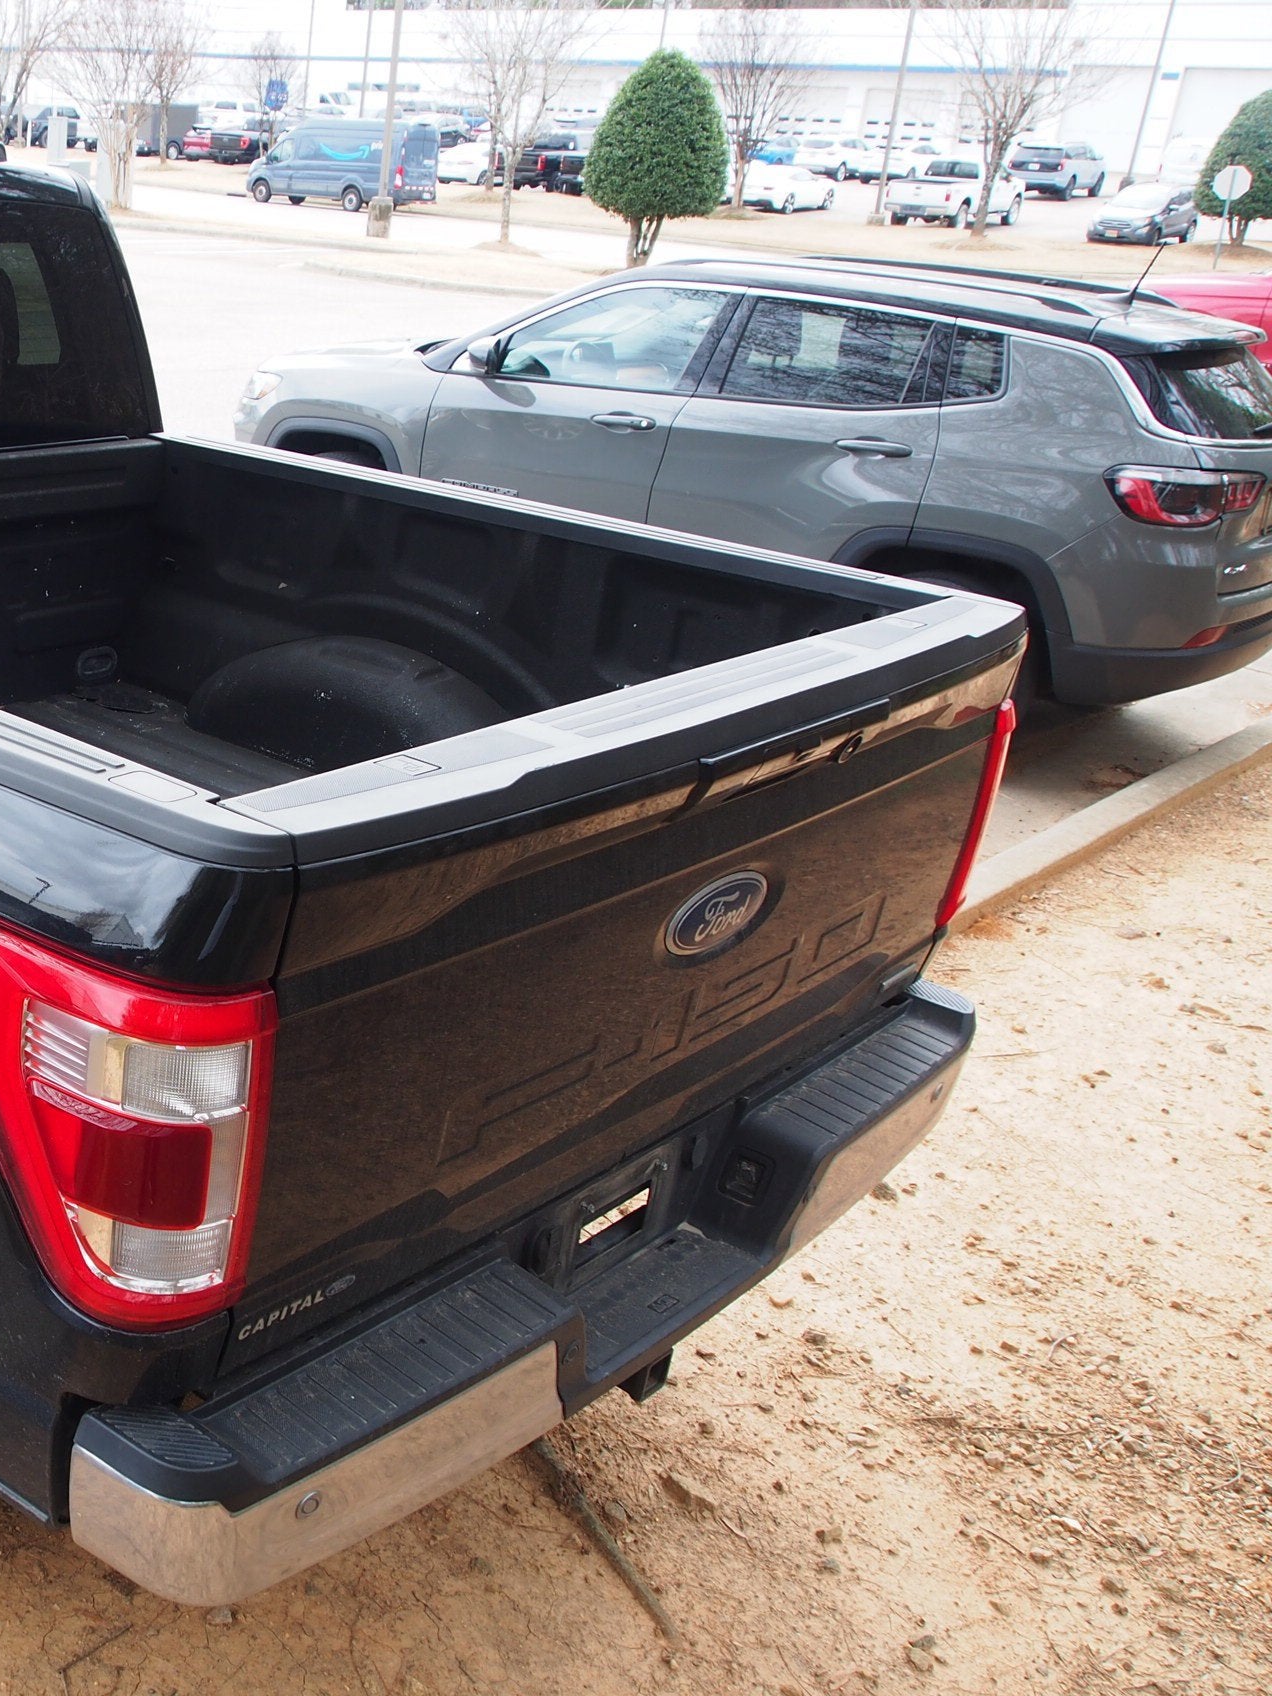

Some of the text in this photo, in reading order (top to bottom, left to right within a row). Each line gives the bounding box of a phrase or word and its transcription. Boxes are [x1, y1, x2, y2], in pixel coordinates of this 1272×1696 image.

[694, 891, 752, 942] Ford
[434, 893, 888, 1168] F-150
[238, 1289, 325, 1341] CAPITAL
